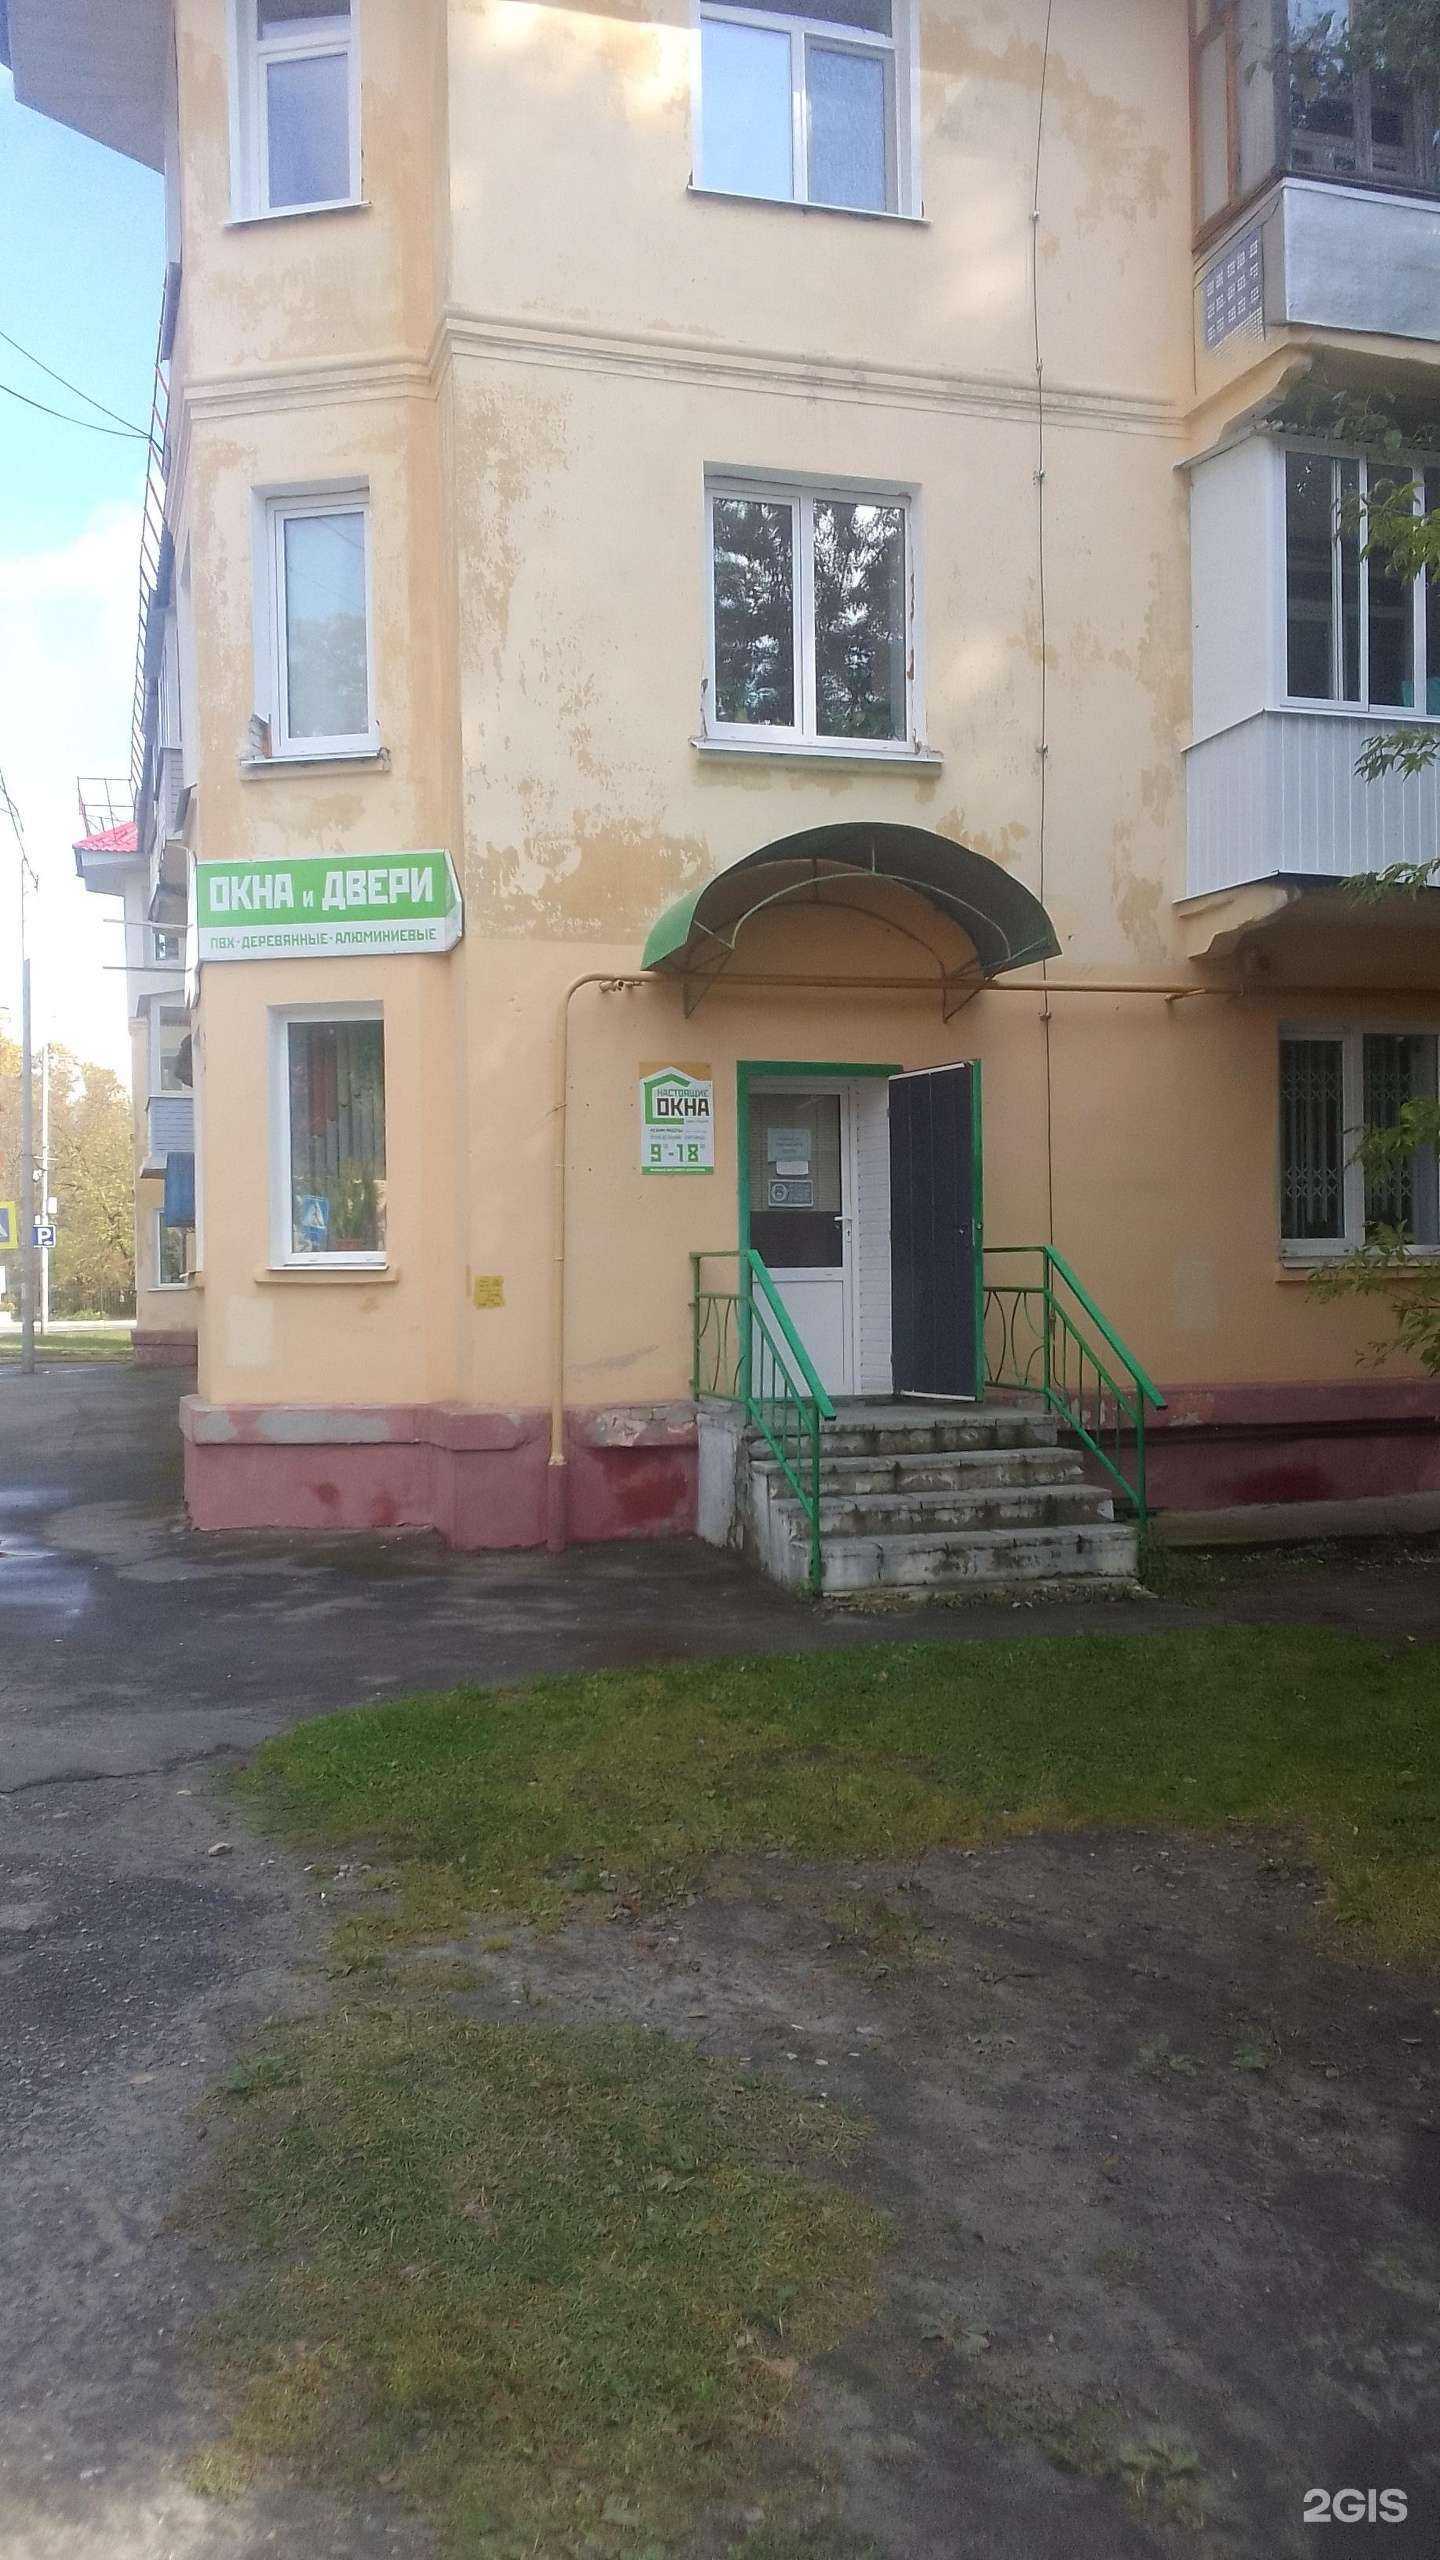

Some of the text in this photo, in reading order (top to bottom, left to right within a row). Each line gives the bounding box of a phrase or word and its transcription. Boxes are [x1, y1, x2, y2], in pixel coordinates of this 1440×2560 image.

[209, 873, 294, 912] ОКНА
[321, 867, 433, 911] ДВЕРИ
[241, 932, 328, 949] ДЕРЕВЯННЫЕ
[335, 928, 436, 945] АЛЮМИНИЕВЫЕ
[656, 1098, 710, 1116] ОКНА
